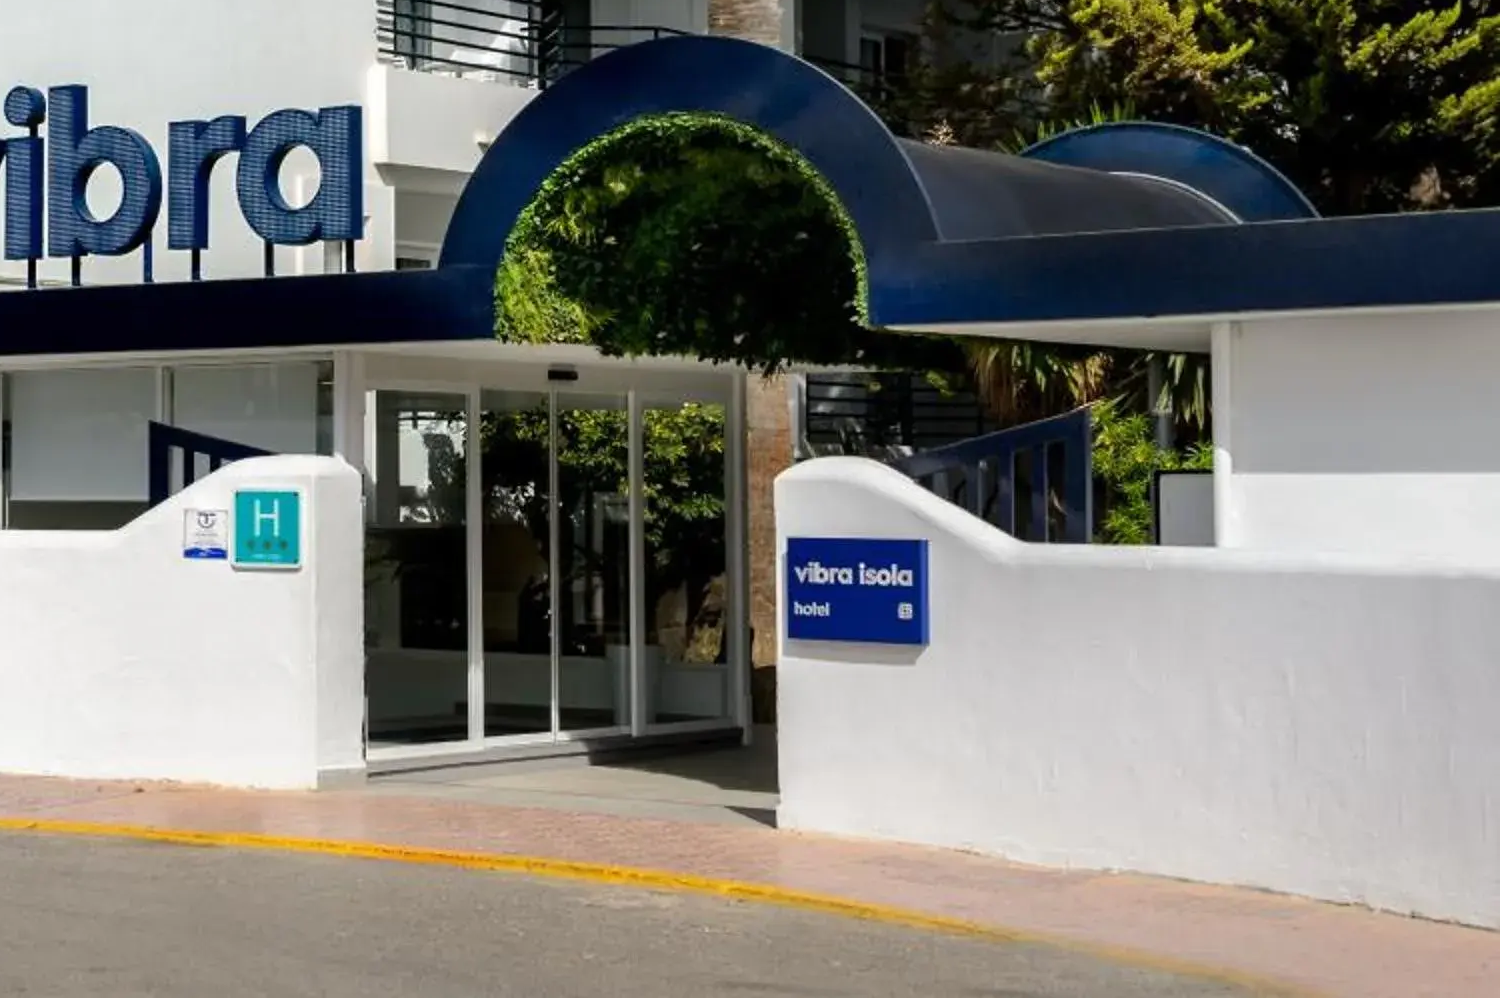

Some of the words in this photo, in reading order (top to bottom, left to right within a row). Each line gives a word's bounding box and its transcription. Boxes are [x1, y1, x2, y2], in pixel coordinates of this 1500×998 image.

[254, 499, 279, 537] H
[794, 561, 853, 585] vibra
[859, 562, 913, 587] isola
[794, 601, 831, 617] hotel
